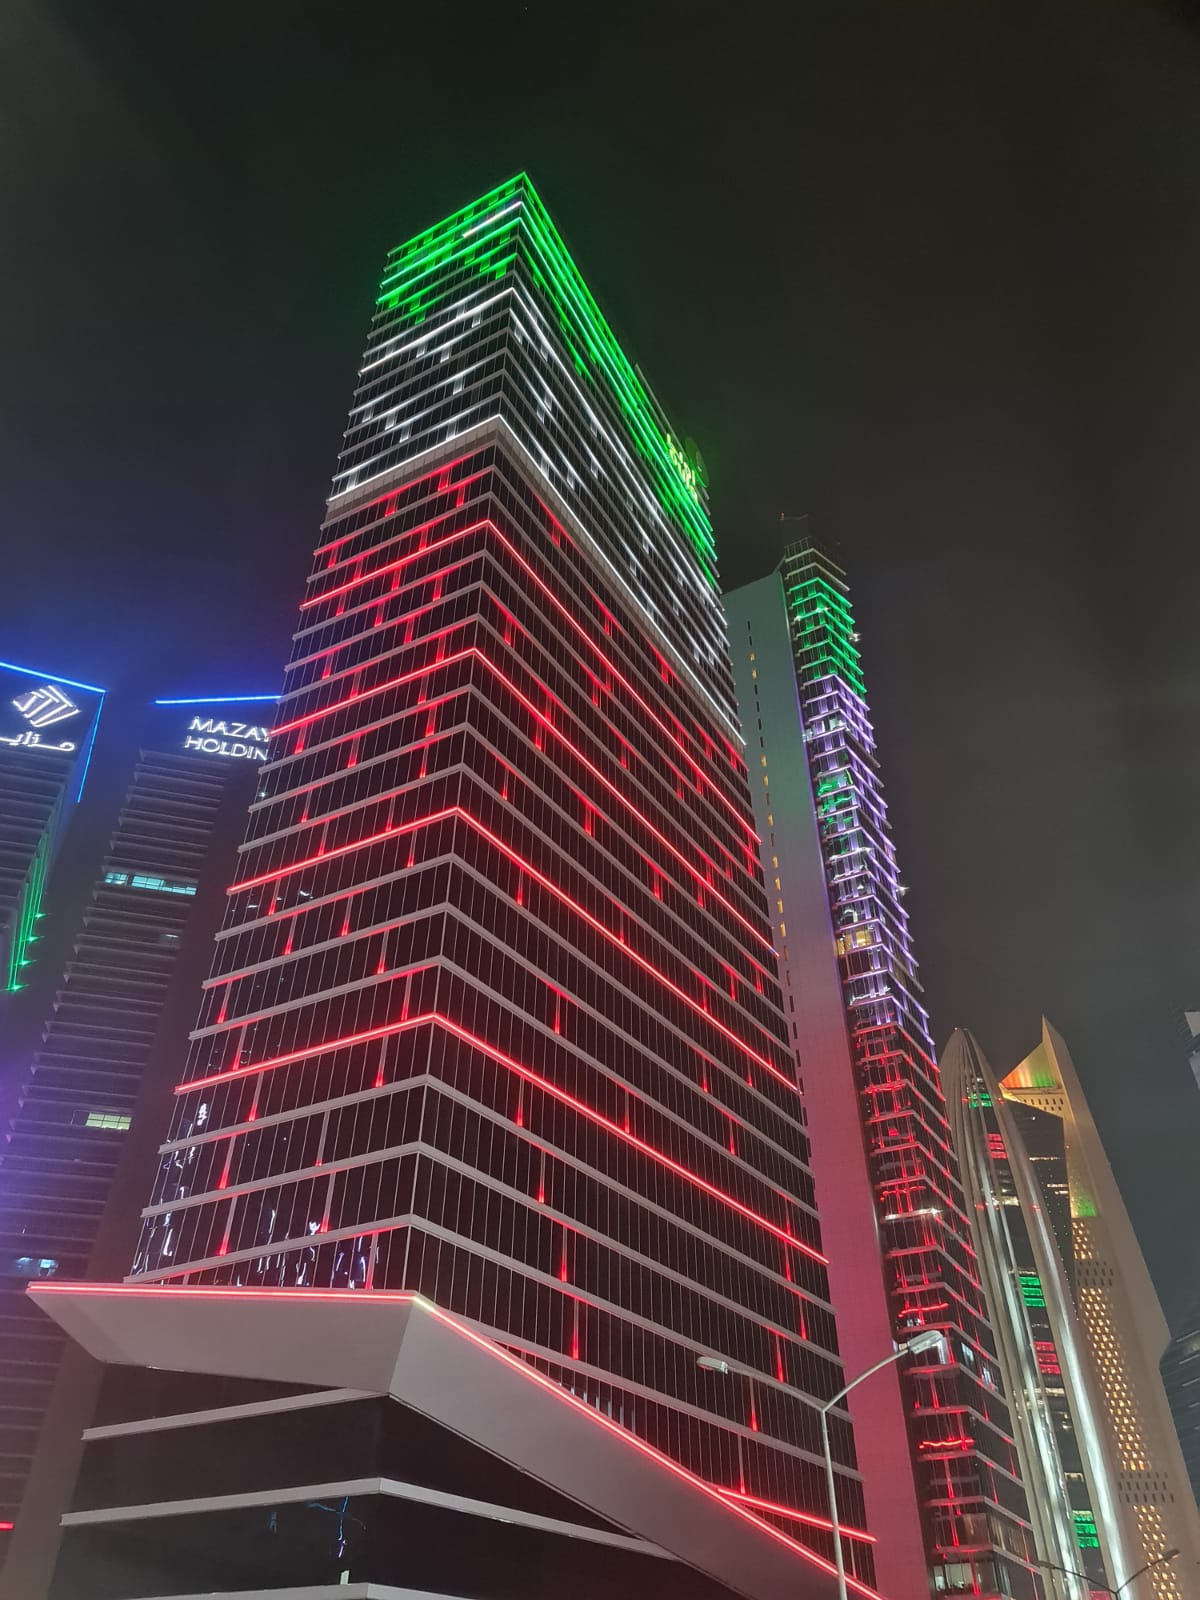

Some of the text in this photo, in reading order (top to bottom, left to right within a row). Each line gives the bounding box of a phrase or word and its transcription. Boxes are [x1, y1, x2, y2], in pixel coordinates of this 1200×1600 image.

[0, 731, 75, 752] مزاي
[187, 716, 270, 742] MAZAY
[184, 736, 269, 761] HOLDIN
